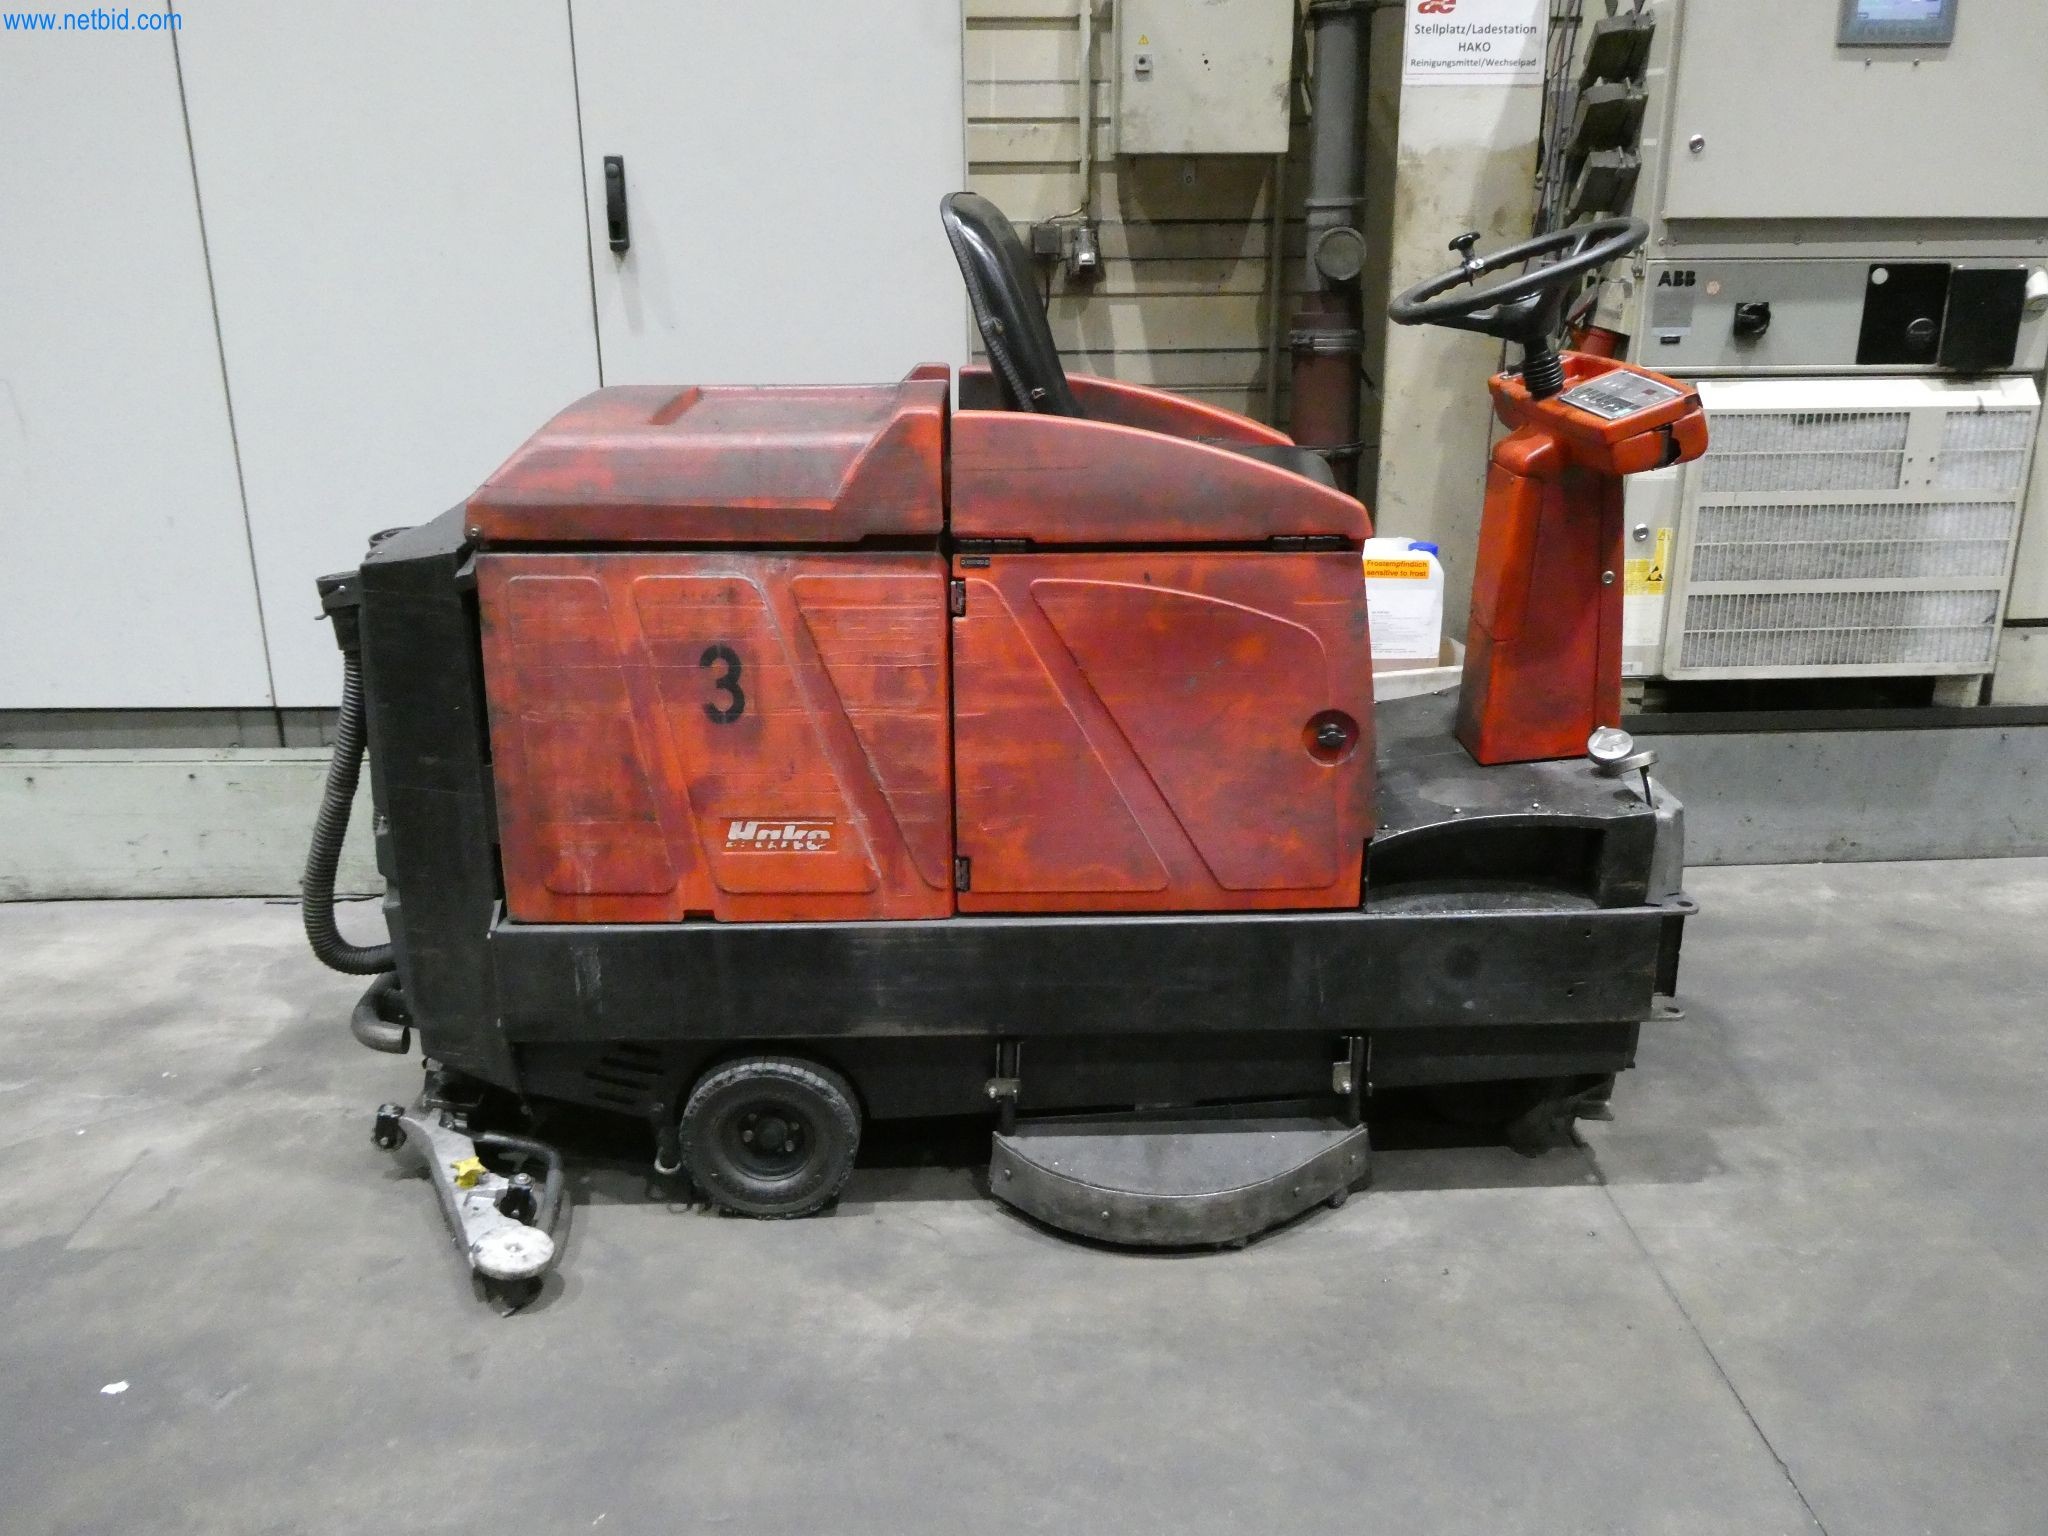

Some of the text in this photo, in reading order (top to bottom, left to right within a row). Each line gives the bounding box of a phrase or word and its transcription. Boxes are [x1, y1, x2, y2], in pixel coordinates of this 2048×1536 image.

[1414, 23, 1537, 36] Stellplatz/Ladestation
[1458, 42, 1491, 52] HAKO
[1410, 57, 1537, 68] Reinigungsmittel/Wechselpad
[1658, 270, 1696, 287] ABB
[1366, 560, 1428, 568] Frostempfindlich
[699, 643, 745, 725] 3
[725, 821, 831, 851] Hako
